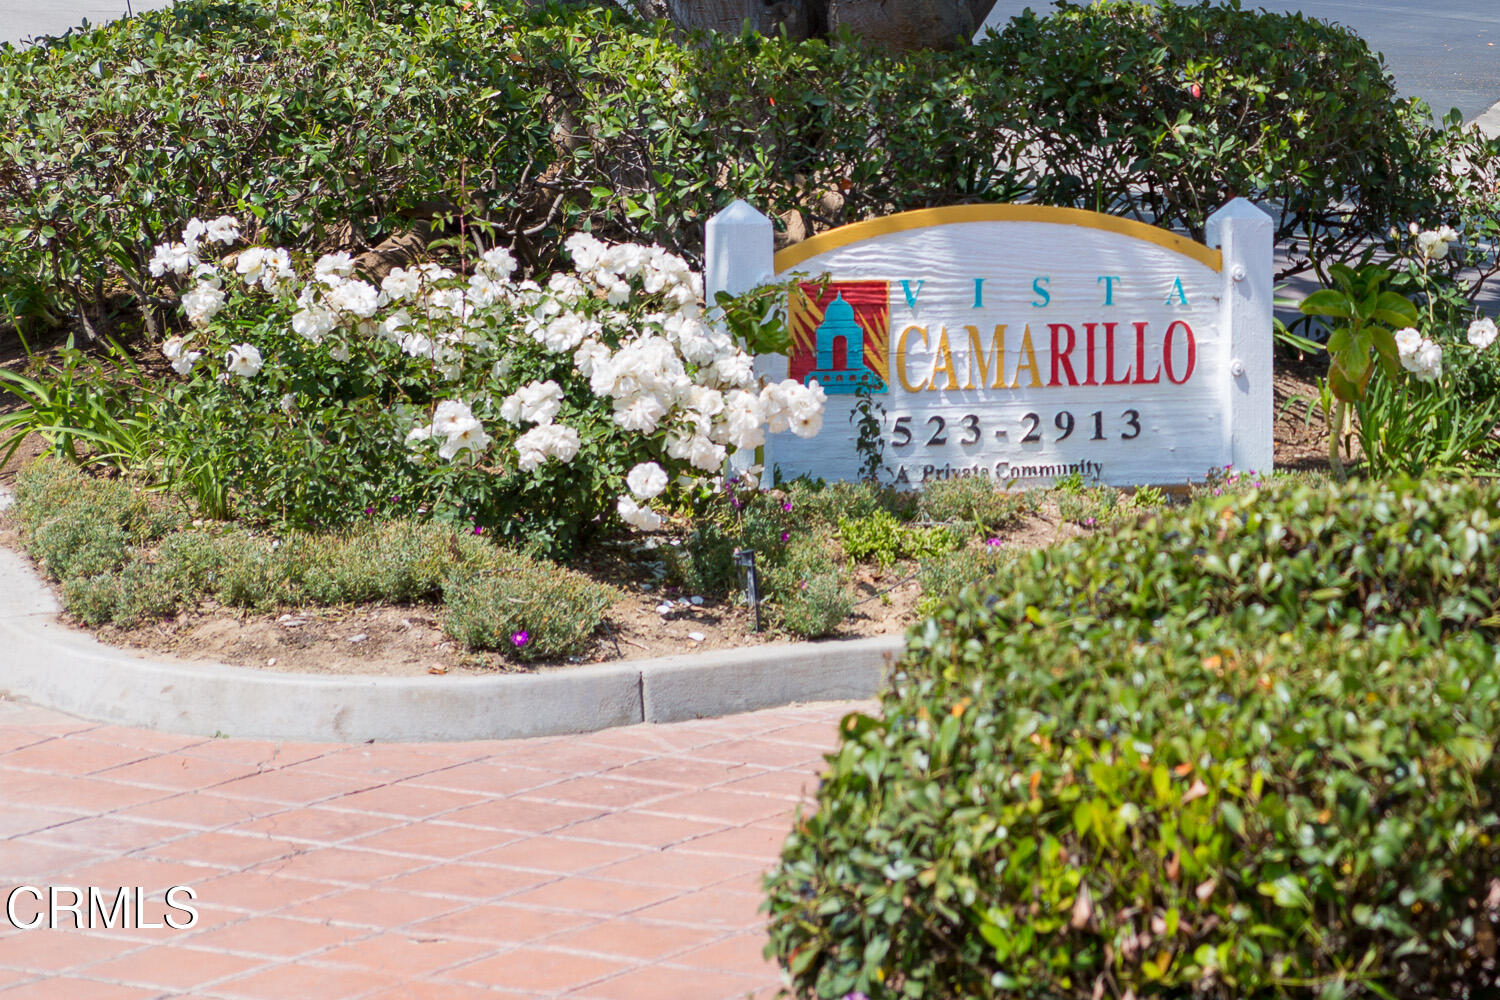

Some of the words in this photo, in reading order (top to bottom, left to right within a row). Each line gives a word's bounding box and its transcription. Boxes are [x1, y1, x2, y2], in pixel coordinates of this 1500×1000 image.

[901, 276, 1188, 308] VISTA
[896, 320, 1196, 392] CAMARILLO
[892, 410, 1142, 447] 523-2913
[894, 465, 909, 484] A
[996, 459, 1103, 481] Community
